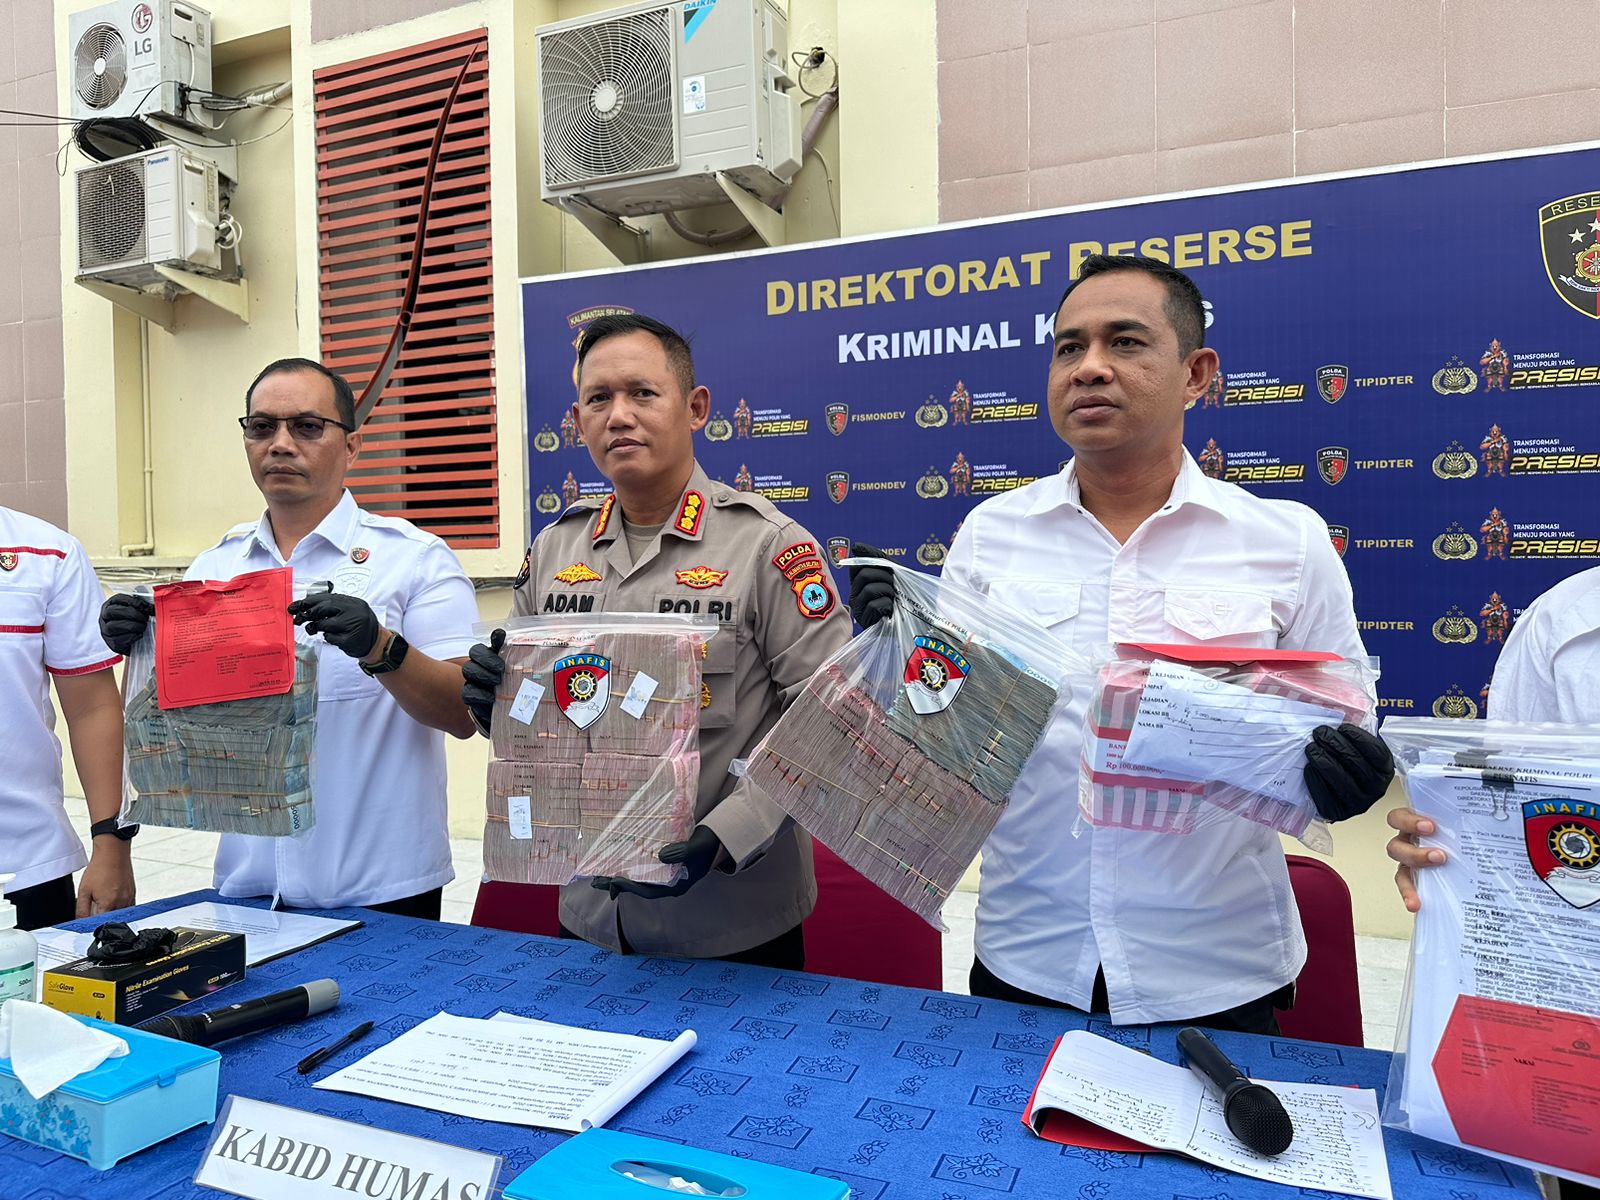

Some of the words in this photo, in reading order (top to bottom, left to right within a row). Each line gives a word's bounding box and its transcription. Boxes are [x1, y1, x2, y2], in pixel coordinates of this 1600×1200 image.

[684, 0, 716, 10] DAIKIN
[134, 38, 152, 56] LG
[148, 156, 170, 165] Panasonic
[1551, 195, 1600, 216] RESE
[766, 251, 1050, 316] DIREKTORAT
[838, 321, 1020, 364] KRIMINAL
[1513, 352, 1560, 360] TRANSFORMASI
[1354, 376, 1414, 387] TIPIDTER
[1510, 367, 1600, 385] PRESIS
[1224, 384, 1304, 402] PRESISI
[851, 411, 906, 422] FISMONDEV
[970, 404, 1038, 419] PRESISI
[752, 420, 808, 434] PRESISI
[1354, 459, 1414, 470] TIPIDTER
[1510, 454, 1600, 470] PRESIS
[1224, 465, 1305, 480] PRESISI
[852, 481, 906, 491] FISMONDEV
[1355, 539, 1414, 548] TIPIDTER
[1510, 540, 1600, 554] PRESIS
[779, 544, 812, 566] POLDA
[543, 593, 594, 612] ADAM
[658, 598, 732, 621] POLRI
[1356, 621, 1414, 631] TIPIDTER
[922, 638, 966, 668] INAFIS
[562, 656, 605, 668] INAFIS
[1378, 698, 1414, 708] IDTER
[1106, 762, 1117, 770] Rp
[1516, 768, 1562, 776] KRIMINAL
[1533, 803, 1596, 816] INAFI
[48, 981, 74, 991] SafeGlove
[125, 982, 142, 993] Nitrile
[142, 971, 173, 987] Examination
[173, 965, 190, 975] Gloves
[215, 1124, 332, 1182] KABID
[332, 1152, 482, 1200] HUMAS
